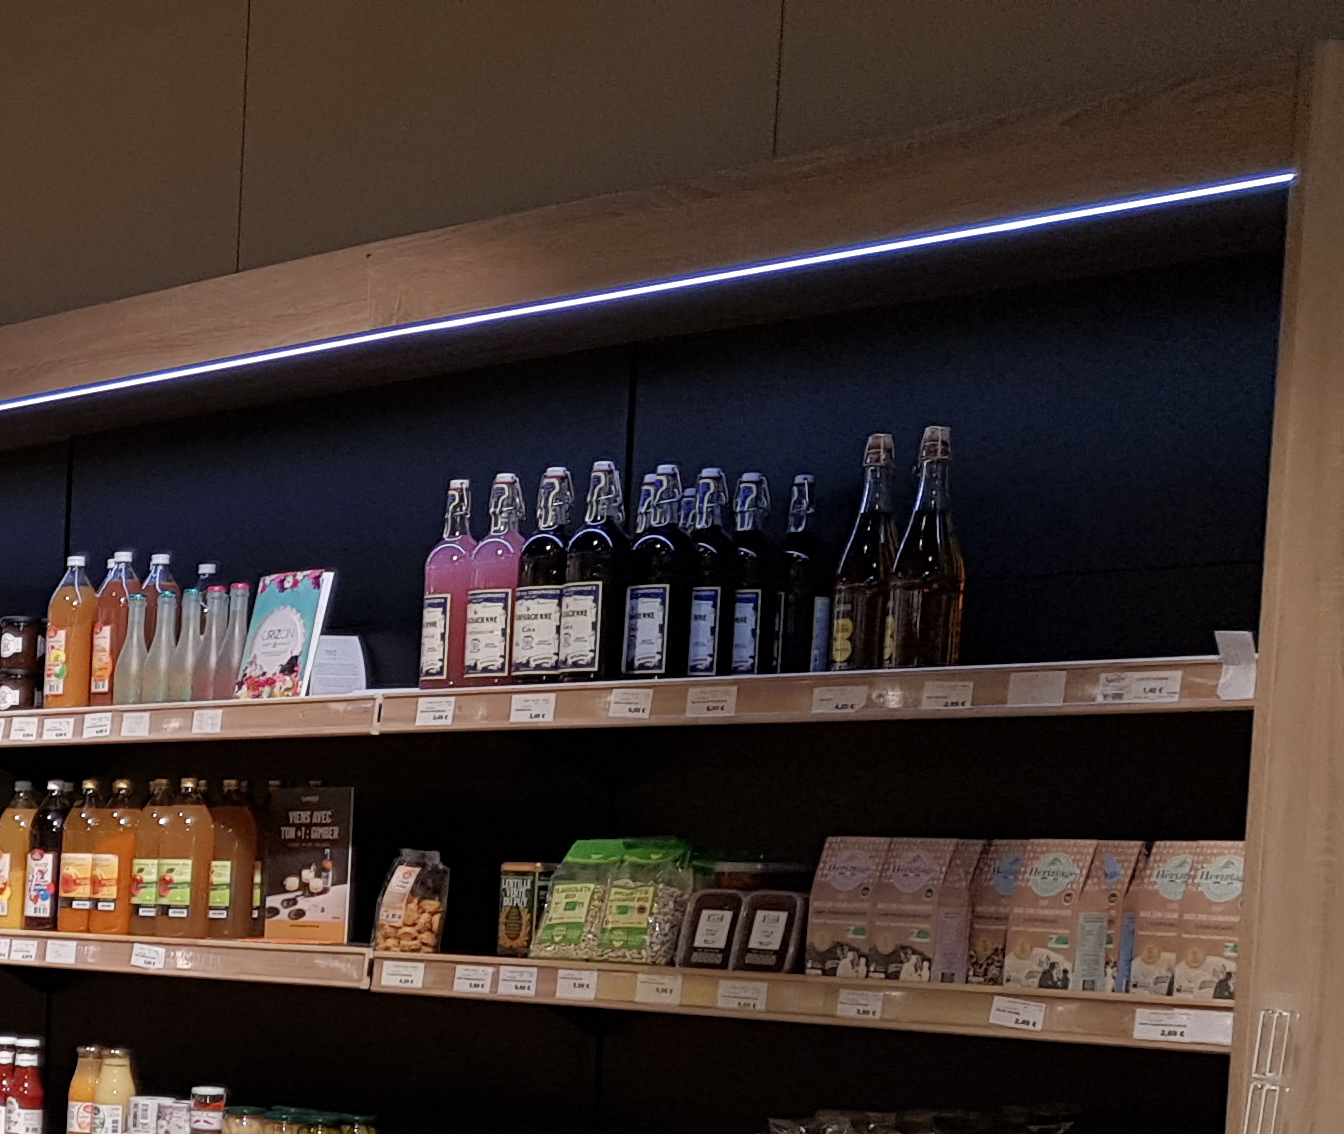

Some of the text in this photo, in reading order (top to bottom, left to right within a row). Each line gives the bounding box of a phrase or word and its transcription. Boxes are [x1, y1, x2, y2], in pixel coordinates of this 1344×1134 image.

[288, 810, 333, 824] VIENS AVEC
[311, 826, 339, 840] GIMBER
[502, 878, 532, 889] LENTILLE
